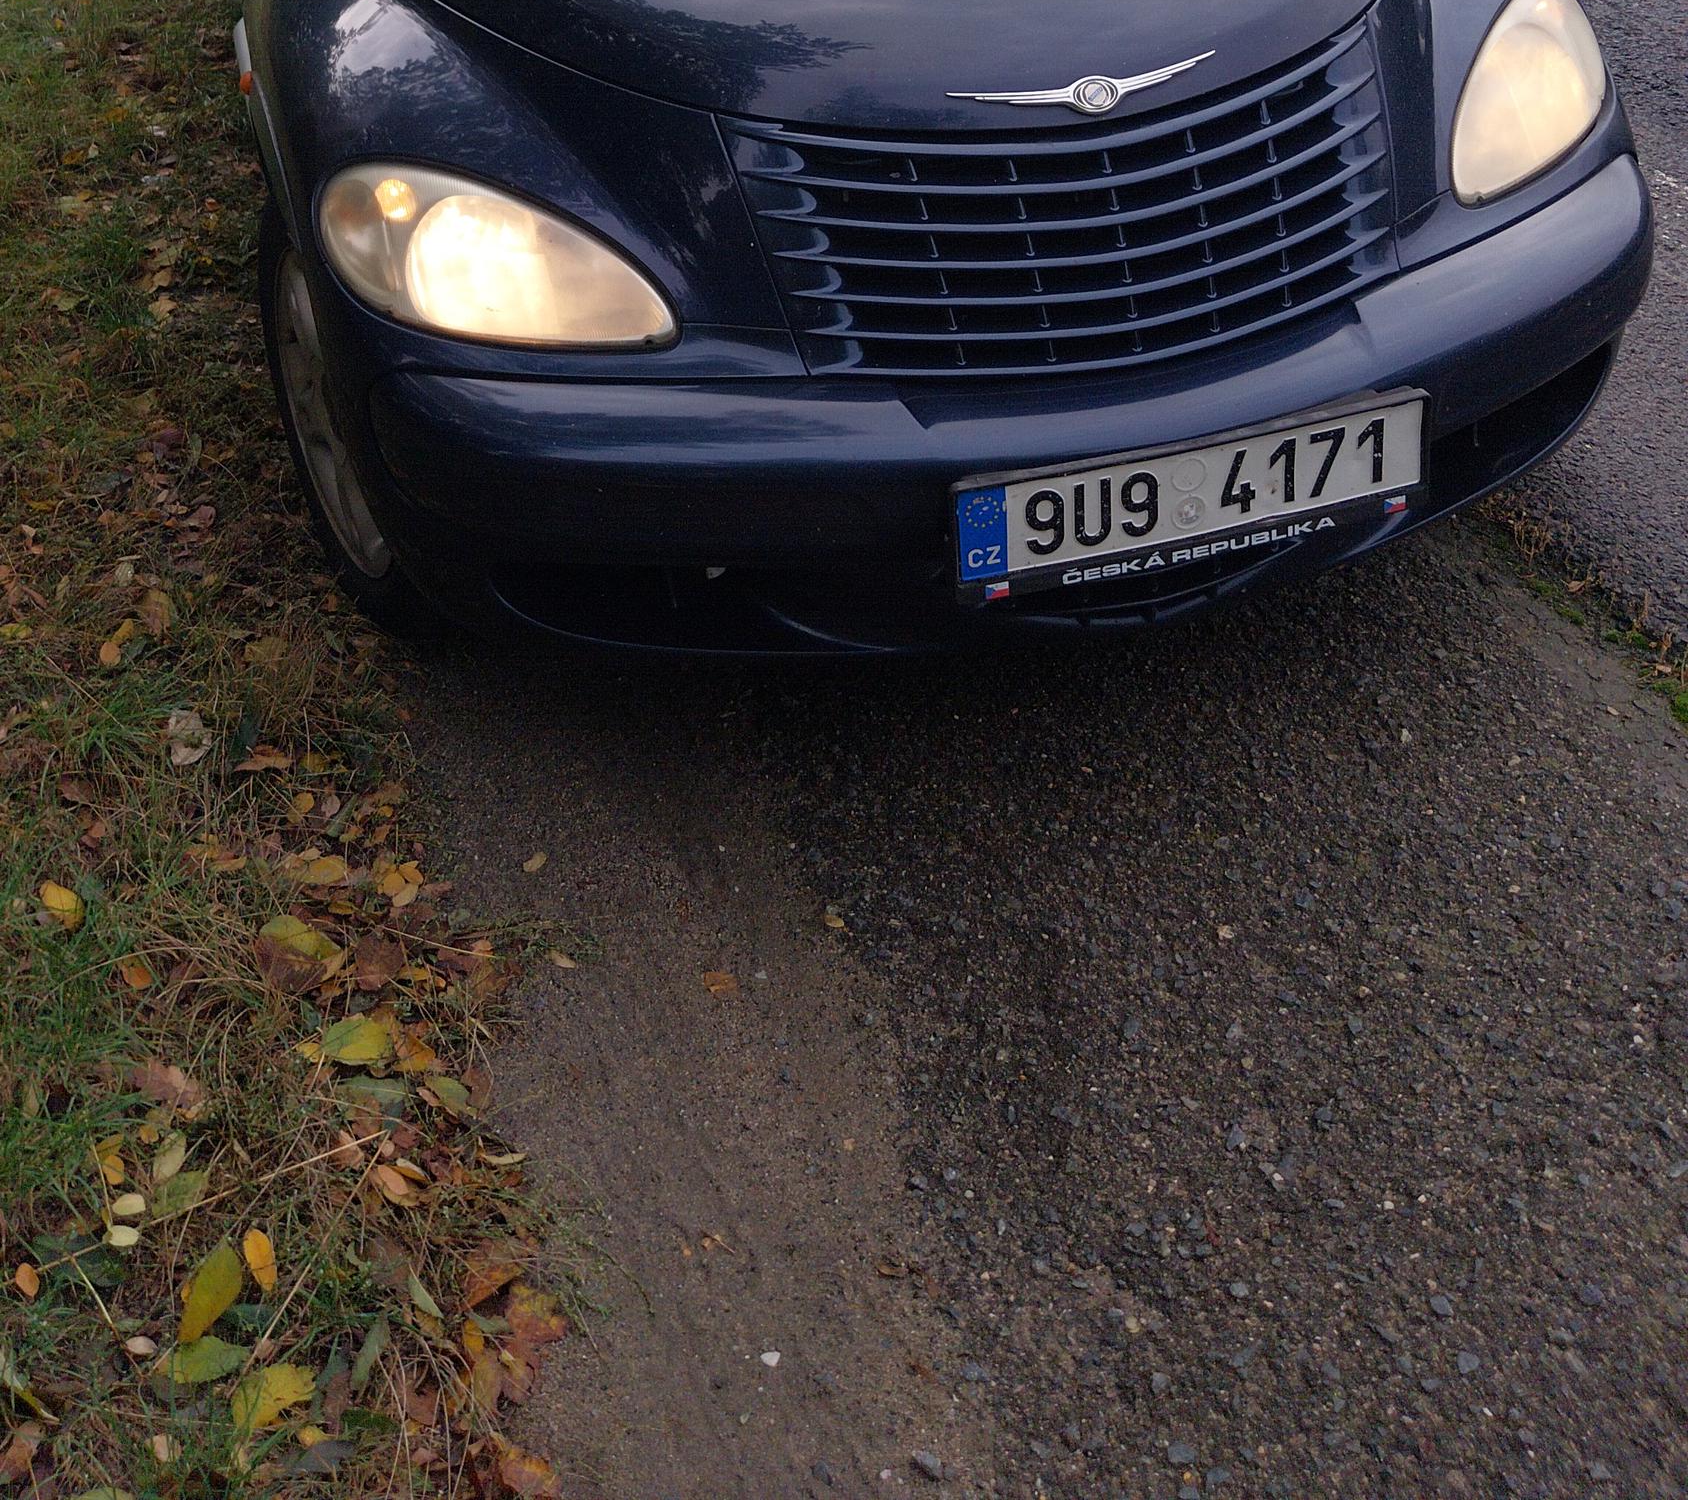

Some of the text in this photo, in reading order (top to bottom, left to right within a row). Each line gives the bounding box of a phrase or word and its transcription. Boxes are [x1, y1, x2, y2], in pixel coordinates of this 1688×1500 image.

[1025, 417, 1386, 555] 9U9 4171
[968, 544, 1001, 569] CZ
[1062, 515, 1337, 586] ČESKÁ REPUBLIKA
